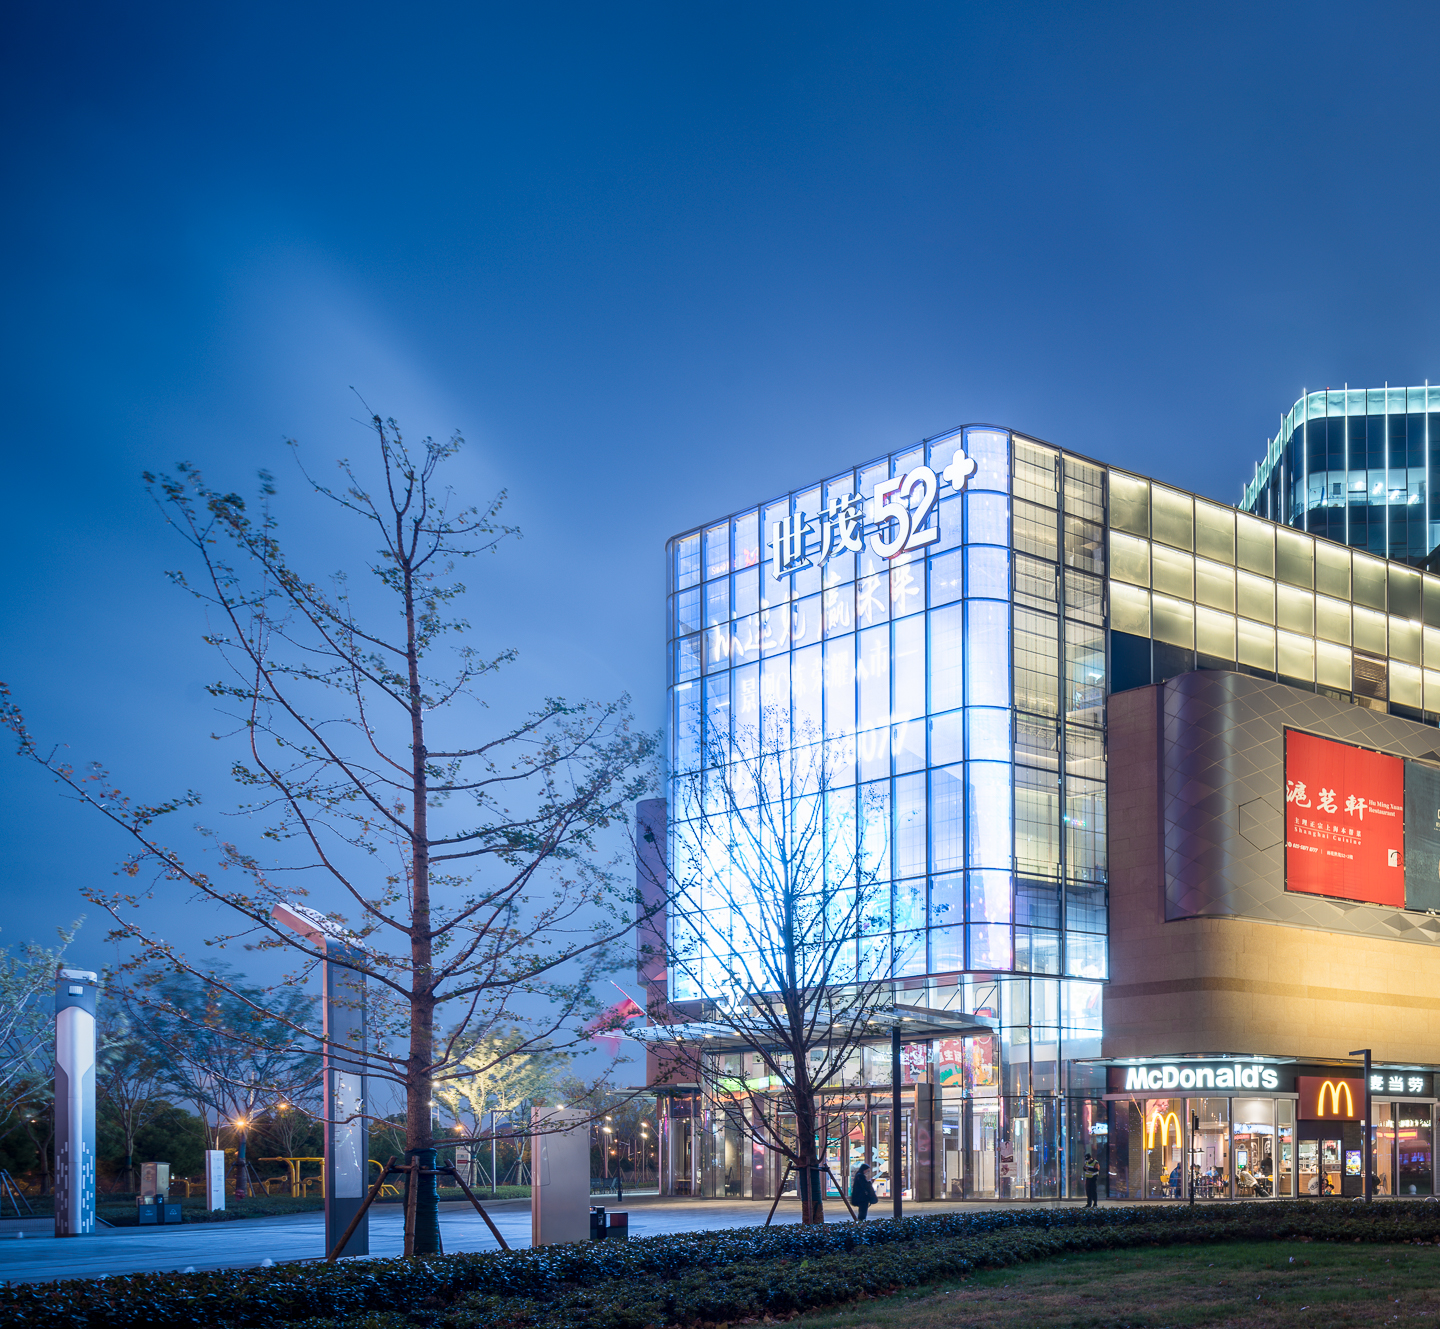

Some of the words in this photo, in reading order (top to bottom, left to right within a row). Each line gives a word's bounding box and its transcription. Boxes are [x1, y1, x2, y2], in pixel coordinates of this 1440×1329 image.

[1294, 826, 1329, 840] Shanghai
[1332, 835, 1362, 846] Cuisine
[1125, 1064, 1279, 1090] McDonald's
[1370, 1075, 1424, 1093] 麦当劳
